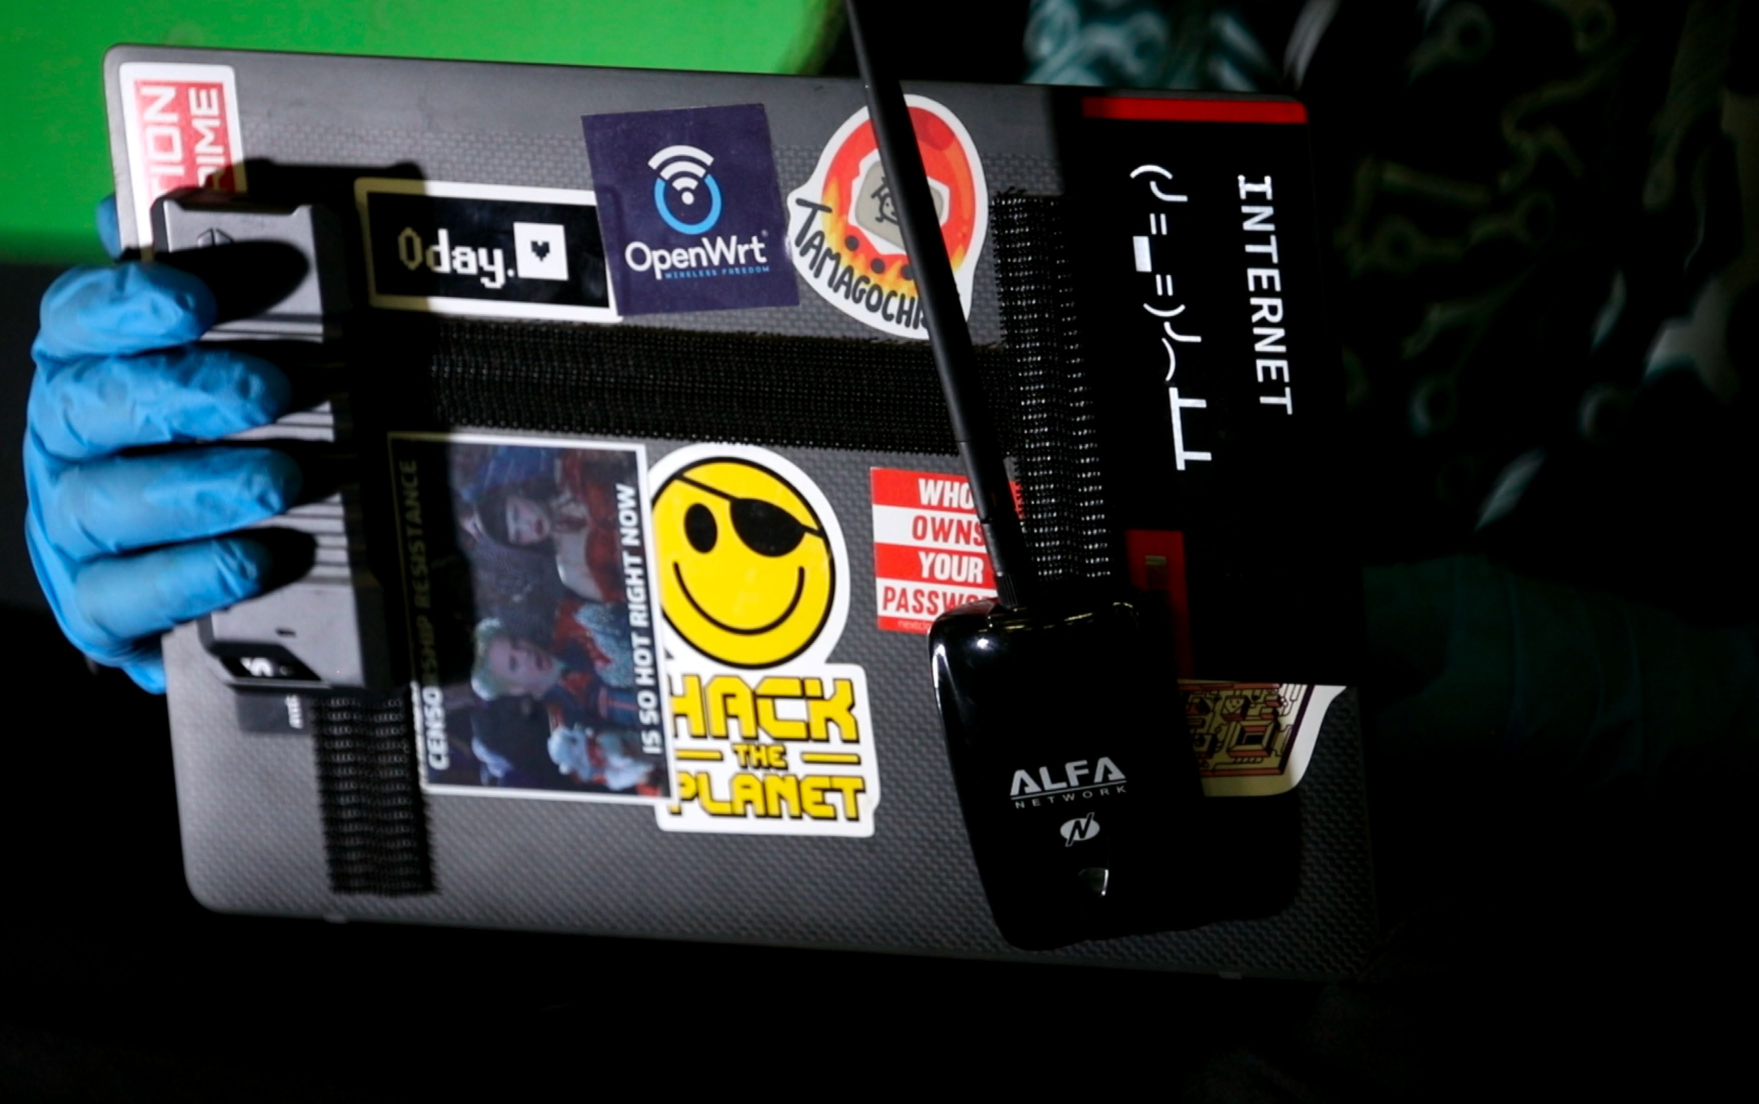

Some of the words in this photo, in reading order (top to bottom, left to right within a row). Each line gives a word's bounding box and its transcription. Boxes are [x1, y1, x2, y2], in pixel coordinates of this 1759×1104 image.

[624, 234, 768, 281] OpenWrt
[664, 269, 718, 280] WIRELESS
[721, 265, 771, 276] FREEDOM
[1236, 173, 1294, 416] INTERNET
[614, 482, 642, 547] NOW
[917, 477, 976, 511] WHO
[398, 457, 433, 610] RESISTANCE
[912, 514, 987, 547] OWNS
[917, 550, 985, 585] YOUR
[621, 550, 649, 629] RIGHT
[882, 586, 988, 616] PASSW
[631, 631, 656, 686] HOT
[414, 613, 450, 771] CENSORSHIP
[636, 690, 662, 727] SO
[669, 674, 860, 744] HACK
[642, 729, 664, 755] IS
[730, 742, 788, 770] THE
[668, 770, 866, 821] PLANET
[1009, 756, 1128, 797] ALFA
[1014, 785, 1128, 810] NETWORK
